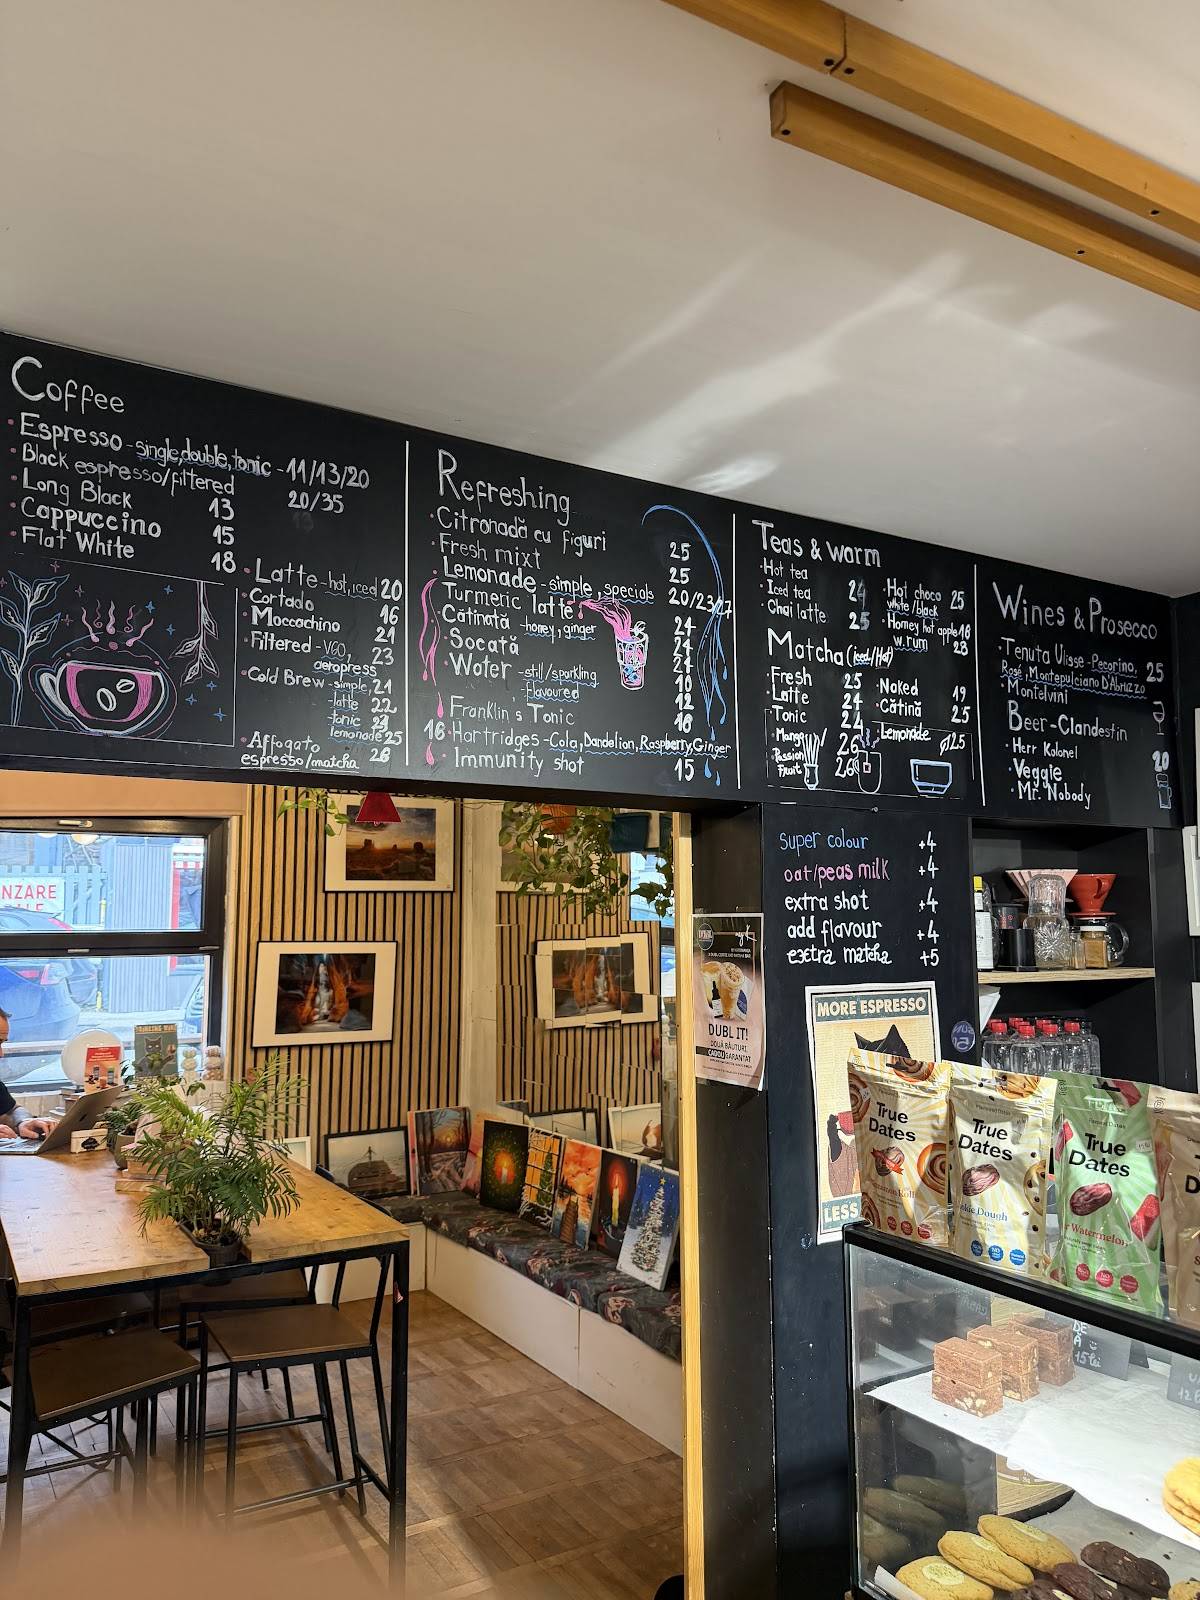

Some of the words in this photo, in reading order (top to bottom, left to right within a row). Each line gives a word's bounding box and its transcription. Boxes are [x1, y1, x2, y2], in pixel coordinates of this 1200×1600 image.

[12, 356, 124, 414] Coffee
[20, 412, 122, 450] Espresso
[23, 442, 69, 469] Black
[288, 490, 344, 513] 20/35
[438, 449, 570, 526] Refreshing
[23, 467, 69, 506] Long
[81, 480, 132, 509] Black
[208, 498, 235, 520] 13
[21, 497, 161, 537] Cappuccino
[213, 525, 235, 545] 15
[437, 506, 527, 539] Citronadă
[534, 529, 551, 543] cu
[563, 531, 606, 557] figuri
[22, 526, 67, 549] Flat
[76, 532, 135, 559] White
[211, 551, 236, 574] 18
[440, 533, 487, 561] Fresh
[495, 546, 541, 569] mixt
[669, 567, 691, 584] 25
[670, 542, 691, 561] 25
[752, 520, 803, 557] Teas
[810, 538, 822, 561] &
[826, 541, 881, 568] warm
[256, 558, 318, 588] Latte
[381, 578, 402, 601] 20
[443, 556, 536, 593] Lemonade
[764, 557, 784, 577] Hot
[790, 563, 808, 579] tea
[767, 579, 788, 598] Iced
[793, 585, 811, 600] tea
[887, 577, 907, 599] Hot
[914, 583, 941, 601] choco
[950, 590, 965, 610] 25
[250, 588, 315, 611] Cortado
[380, 604, 400, 625] 16
[442, 582, 522, 609] Turmeric
[533, 594, 573, 620] latte
[674, 616, 696, 637] 24
[768, 598, 793, 618] Chai
[797, 603, 826, 624] latte
[849, 611, 870, 631] 25
[992, 581, 1065, 627] Wines
[1074, 607, 1085, 630] &
[1089, 597, 1158, 640] Prosecco
[251, 605, 341, 632] Moccachino
[374, 626, 396, 645] 21
[442, 604, 510, 629] Cătinată
[673, 636, 693, 656] 24
[923, 619, 935, 634] hot
[937, 622, 957, 646] apple
[251, 631, 312, 653] Filtered
[372, 647, 394, 665] 23
[450, 628, 519, 655] Socată
[673, 656, 694, 674] 24
[767, 627, 844, 666] Matcha
[953, 640, 968, 656] 28
[1001, 636, 1050, 665] Tenuta
[1055, 643, 1084, 668] Ulisse
[1146, 662, 1164, 682] 25
[248, 666, 279, 684] Cold
[284, 669, 324, 688] Brew
[372, 679, 392, 695] 21
[314, 661, 377, 681] aeropress
[449, 653, 512, 680] Water
[675, 674, 692, 693] 10
[771, 666, 812, 687] Fresh
[844, 672, 862, 689] 25
[880, 678, 918, 696] Naked
[952, 685, 966, 703] 19
[1029, 666, 1099, 688] Montepulciano
[371, 698, 397, 713] 22
[675, 692, 694, 710] 12
[772, 683, 810, 704] Latte
[842, 692, 863, 710] 24
[880, 698, 921, 717] Cătină
[951, 705, 970, 723] 25
[1007, 679, 1068, 704] Montelvini
[527, 703, 575, 725] Tonic
[772, 704, 807, 723] Tonic
[841, 710, 863, 736] 24
[1008, 700, 1048, 732] Beer
[247, 731, 320, 757] Affogato
[331, 727, 382, 742] lemonade
[384, 731, 404, 746] 25
[424, 719, 445, 741] 16
[453, 720, 539, 752] Hartridges
[881, 722, 931, 742] Lemonade
[1013, 737, 1037, 754] Herr
[455, 747, 543, 777] Immunity
[553, 752, 584, 775] shot
[674, 757, 695, 781] 15
[1013, 758, 1063, 788] Veggie
[1152, 750, 1169, 772] 20
[1018, 781, 1041, 800] Mr.
[1047, 782, 1091, 809] Nobody
[828, 828, 868, 849] colour
[918, 831, 936, 852] +4
[784, 863, 853, 888] oat/peas
[858, 857, 890, 880] milk
[918, 855, 939, 879] +4
[785, 892, 828, 912] extra
[834, 889, 869, 910] shot
[918, 887, 939, 914] +4
[787, 915, 815, 938] add
[821, 919, 882, 946] flavour
[917, 919, 939, 944] +4
[844, 942, 892, 965] matcha
[919, 948, 939, 966] +5
[817, 1000, 857, 1017] MORE
[860, 997, 927, 1014] ESPRESSO
[708, 1023, 733, 1038] DUBL
[737, 1027, 748, 1040] IT!
[877, 1102, 908, 1123] True
[869, 1118, 916, 1142] Dates
[973, 1118, 1008, 1140] True
[1085, 1132, 1126, 1156] True
[958, 1134, 1012, 1161] Dates
[1069, 1149, 1130, 1177] Dates
[822, 1202, 859, 1223] LESS
